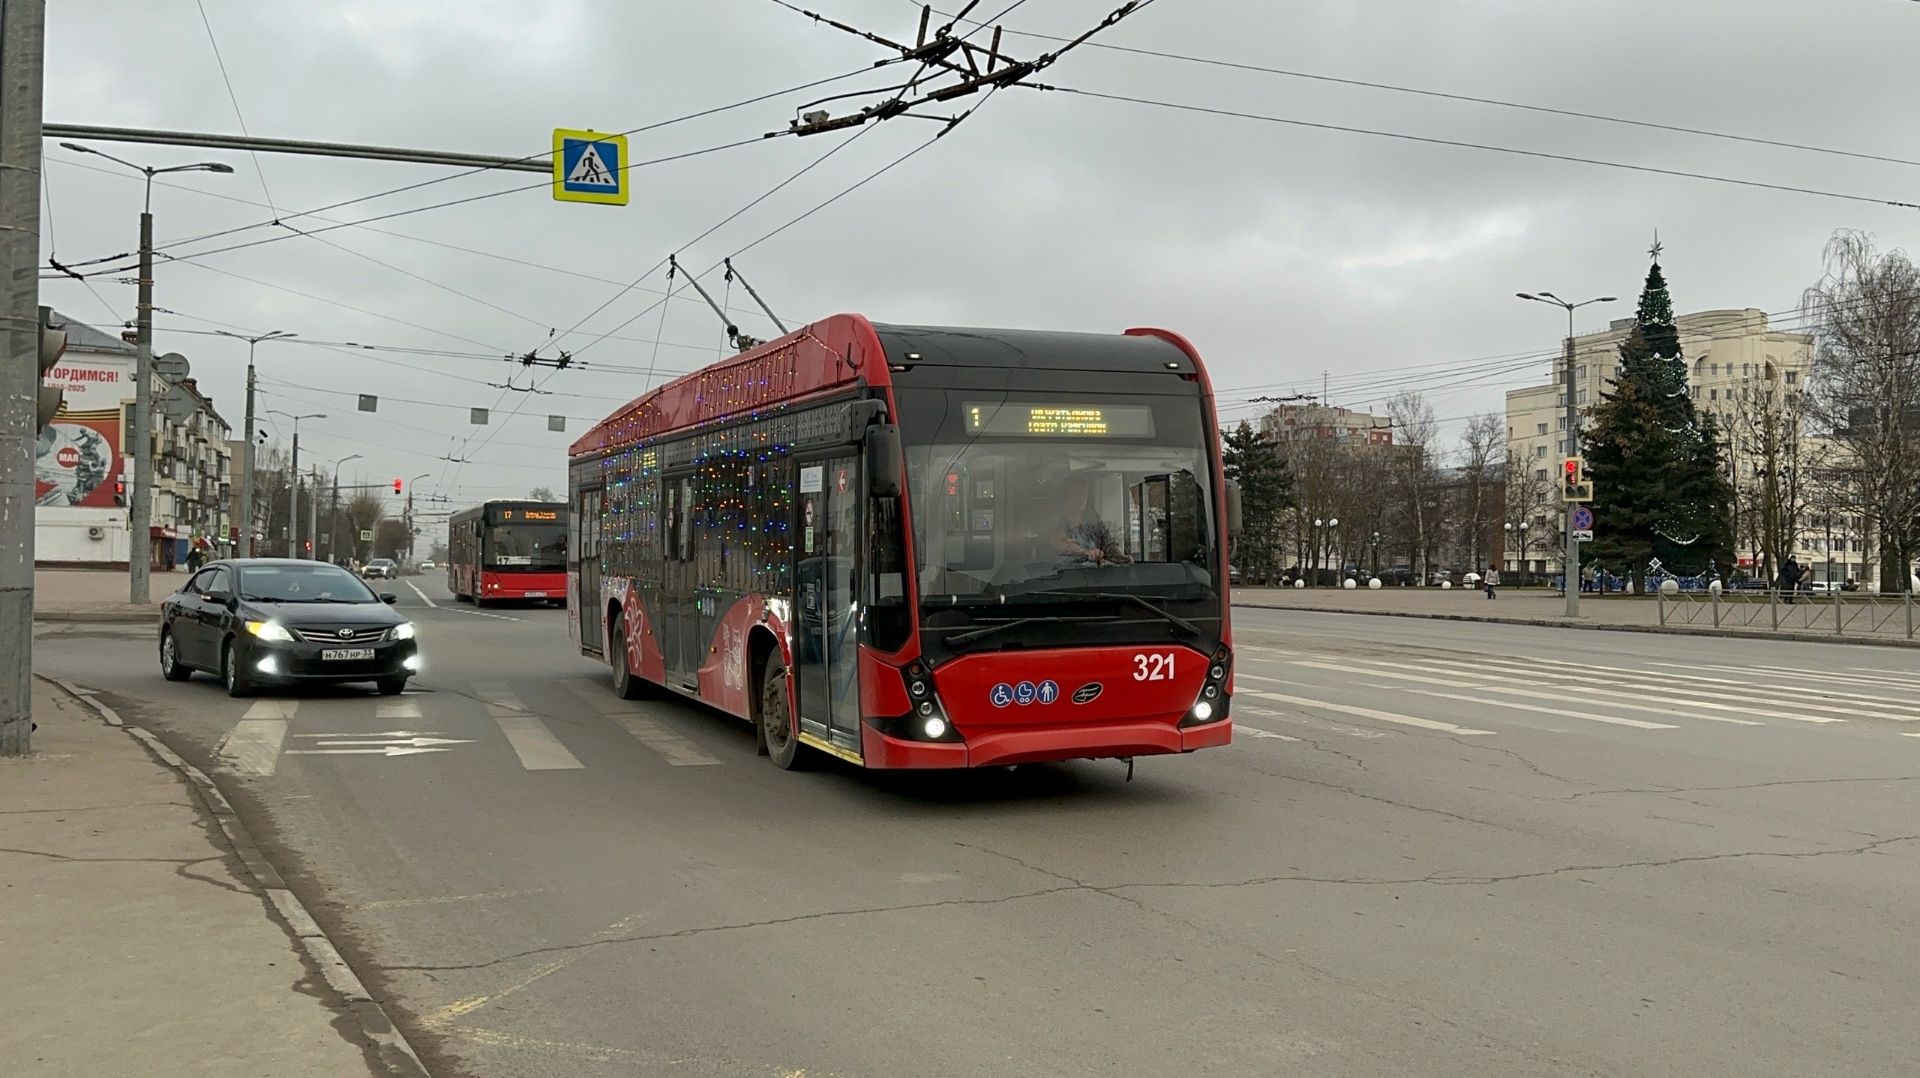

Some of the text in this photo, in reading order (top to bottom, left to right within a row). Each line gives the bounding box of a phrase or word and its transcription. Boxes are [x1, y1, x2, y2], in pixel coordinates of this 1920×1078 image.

[971, 408, 979, 427] 1
[59, 453, 79, 462] МАЯ
[504, 510, 512, 519] 17
[498, 557, 509, 565] 17
[1133, 653, 1174, 680] 321
